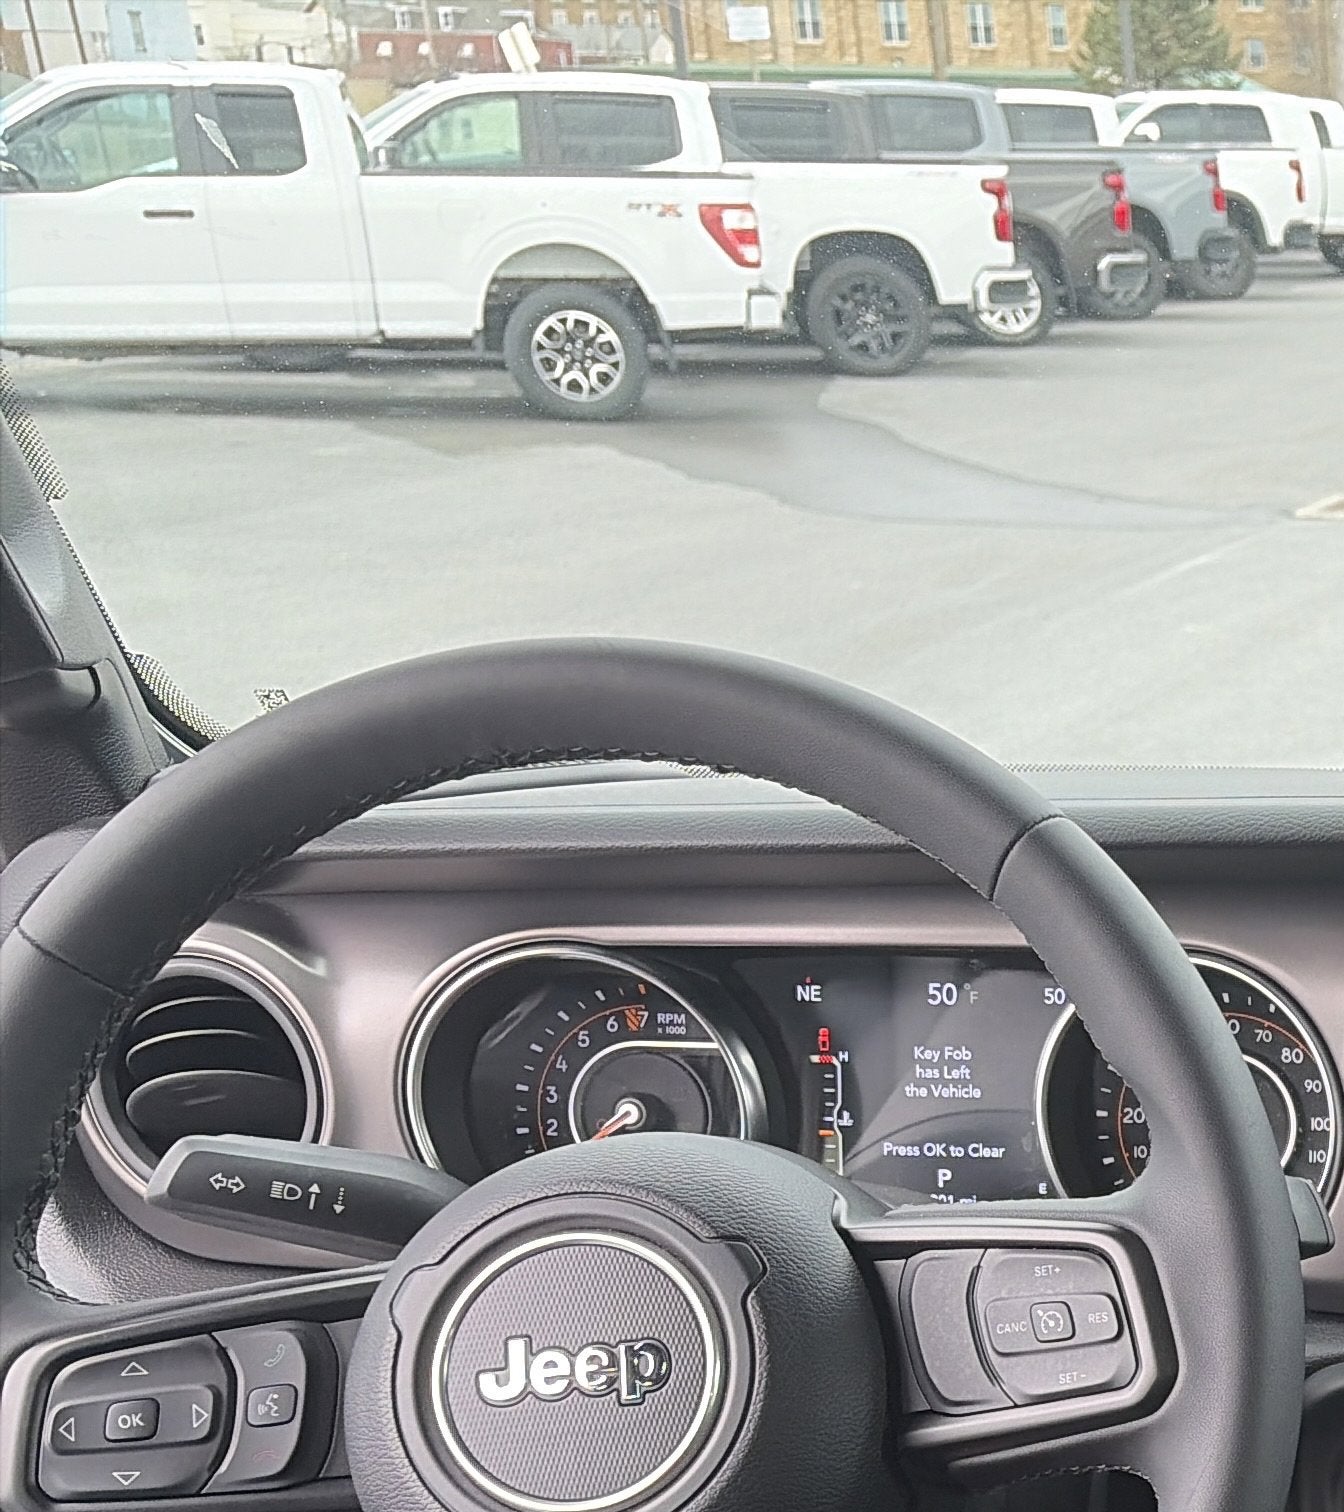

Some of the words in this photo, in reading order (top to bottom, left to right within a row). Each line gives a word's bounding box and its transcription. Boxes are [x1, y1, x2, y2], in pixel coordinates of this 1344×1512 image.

[796, 986, 822, 1002] NE
[927, 982, 957, 1006] 50
[1043, 988, 1066, 1005] 50
[606, 1016, 619, 1033] 6
[638, 1011, 649, 1028] 7
[657, 1013, 686, 1025] RPM
[1227, 1019, 1241, 1034] 0
[666, 1026, 687, 1035] 1000
[1254, 1029, 1273, 1043] 70
[577, 1030, 590, 1048] 5
[838, 1051, 849, 1063] H
[914, 1046, 941, 1062] Key
[944, 1046, 972, 1061] Fob
[1281, 1047, 1304, 1064] 80
[556, 1054, 568, 1073] 4
[916, 1066, 940, 1080] has
[943, 1066, 971, 1080] Left
[904, 1084, 928, 1099] the
[931, 1084, 982, 1099] Vehicle
[1304, 1079, 1322, 1093] 90
[546, 1086, 558, 1104] 3
[1123, 1107, 1146, 1124] 20
[546, 1119, 558, 1137] 2
[1310, 1117, 1331, 1132] 100
[883, 1143, 920, 1157] Press
[923, 1143, 946, 1157] OK
[949, 1145, 964, 1157] to
[968, 1143, 1006, 1158] Clear
[1133, 1145, 1148, 1159] 10
[1308, 1150, 1327, 1163] 110
[937, 1168, 952, 1188] P
[1038, 1182, 1048, 1195] E
[1087, 1312, 1109, 1324] RES
[996, 1321, 1028, 1335] CANC
[478, 1336, 671, 1403] Jeep
[117, 1412, 145, 1429] OK
